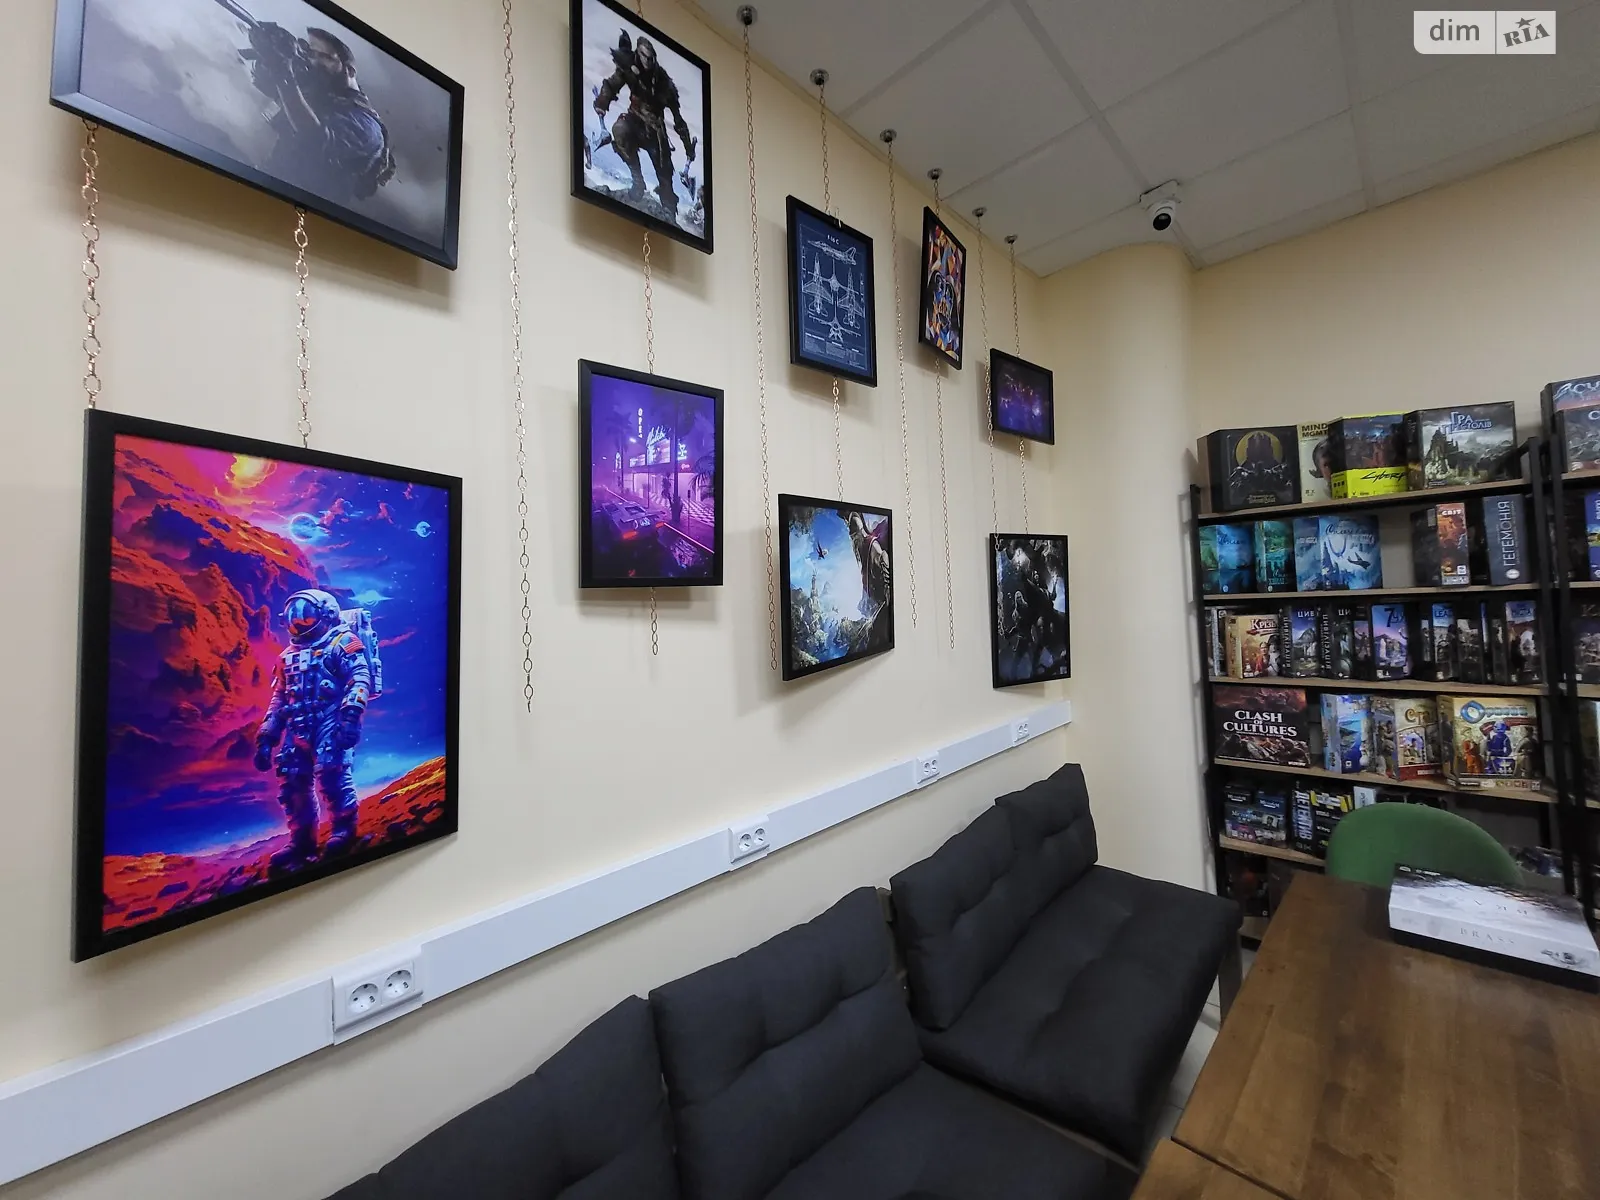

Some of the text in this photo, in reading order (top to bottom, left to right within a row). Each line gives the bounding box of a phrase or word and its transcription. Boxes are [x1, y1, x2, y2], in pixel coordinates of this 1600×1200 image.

[1301, 423, 1328, 432] MIND
[1497, 501, 1516, 566] ГЕГЕМОНІЯ
[1234, 710, 1283, 723] CLASH
[1223, 721, 1298, 737] CULTURES
[1295, 790, 1313, 840] ДЕТЕКТИВ
